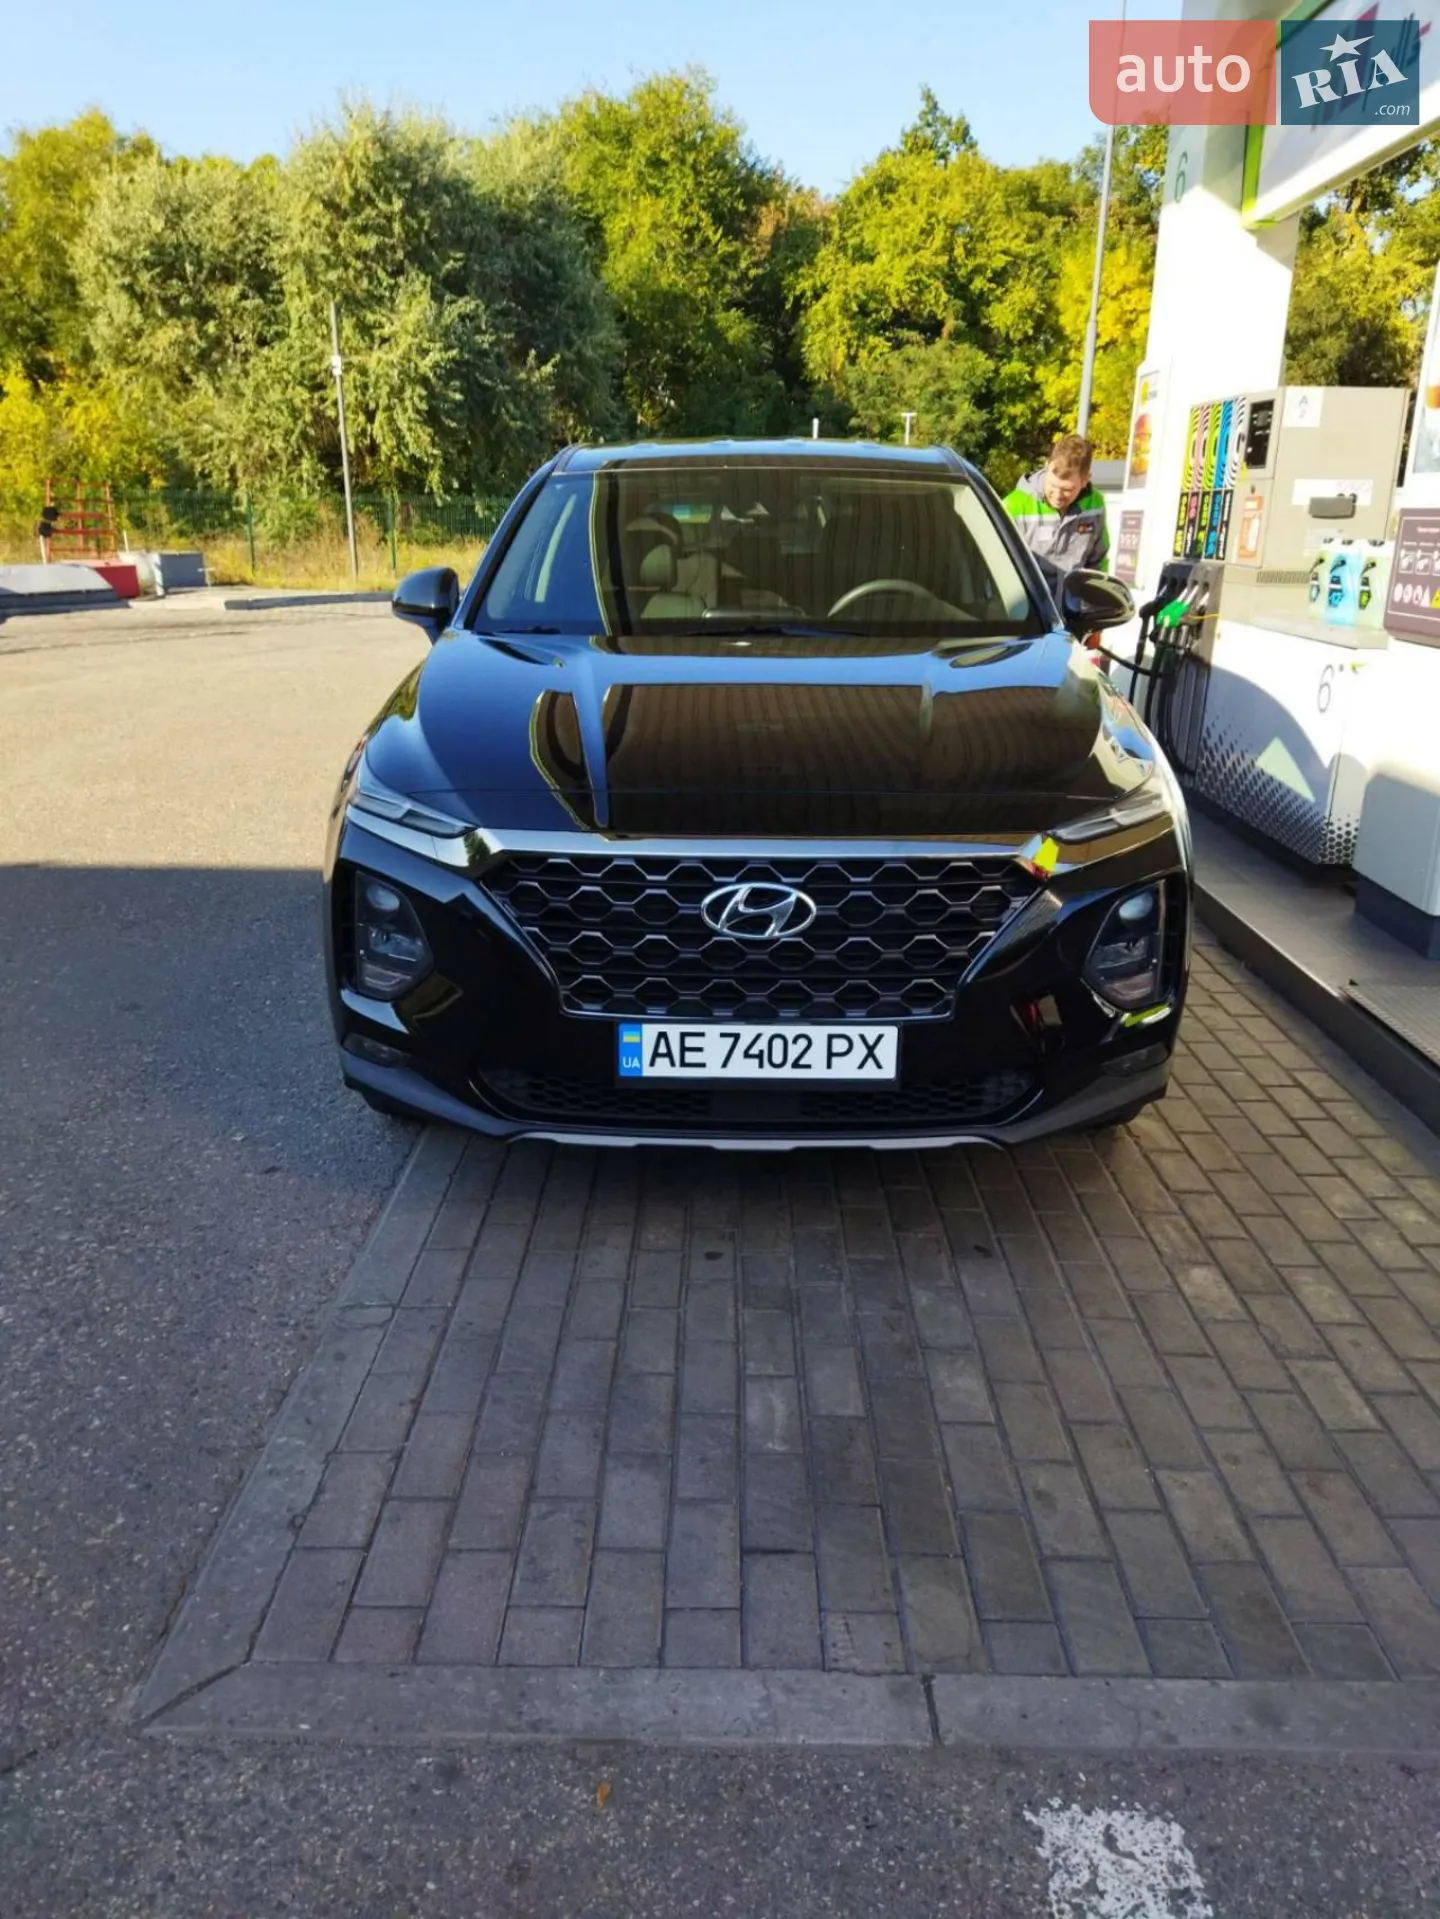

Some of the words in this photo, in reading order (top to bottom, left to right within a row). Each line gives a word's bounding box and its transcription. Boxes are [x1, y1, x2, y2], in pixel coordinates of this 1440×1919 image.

[1174, 150, 1188, 204] 6
[1317, 664, 1334, 714] 6
[622, 1057, 641, 1069] UA
[649, 1031, 706, 1068] AE
[719, 1032, 813, 1070] 7402
[826, 1033, 885, 1070] PX
